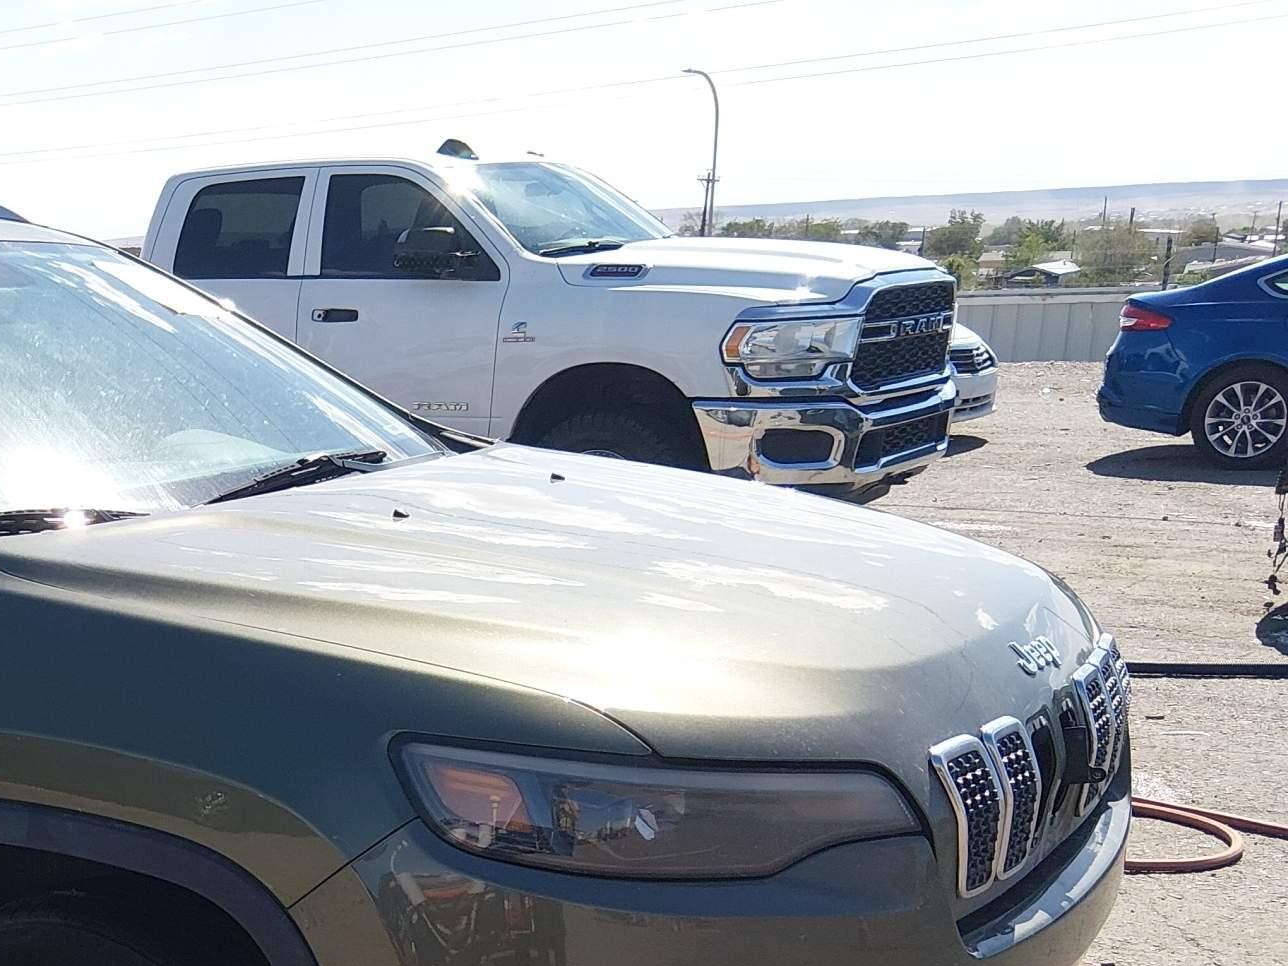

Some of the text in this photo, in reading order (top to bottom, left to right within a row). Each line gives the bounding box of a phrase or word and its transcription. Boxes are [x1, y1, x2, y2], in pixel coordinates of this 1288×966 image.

[899, 315, 945, 336] RAM
[411, 400, 469, 411] RAM
[1008, 636, 1062, 675] Jeep
